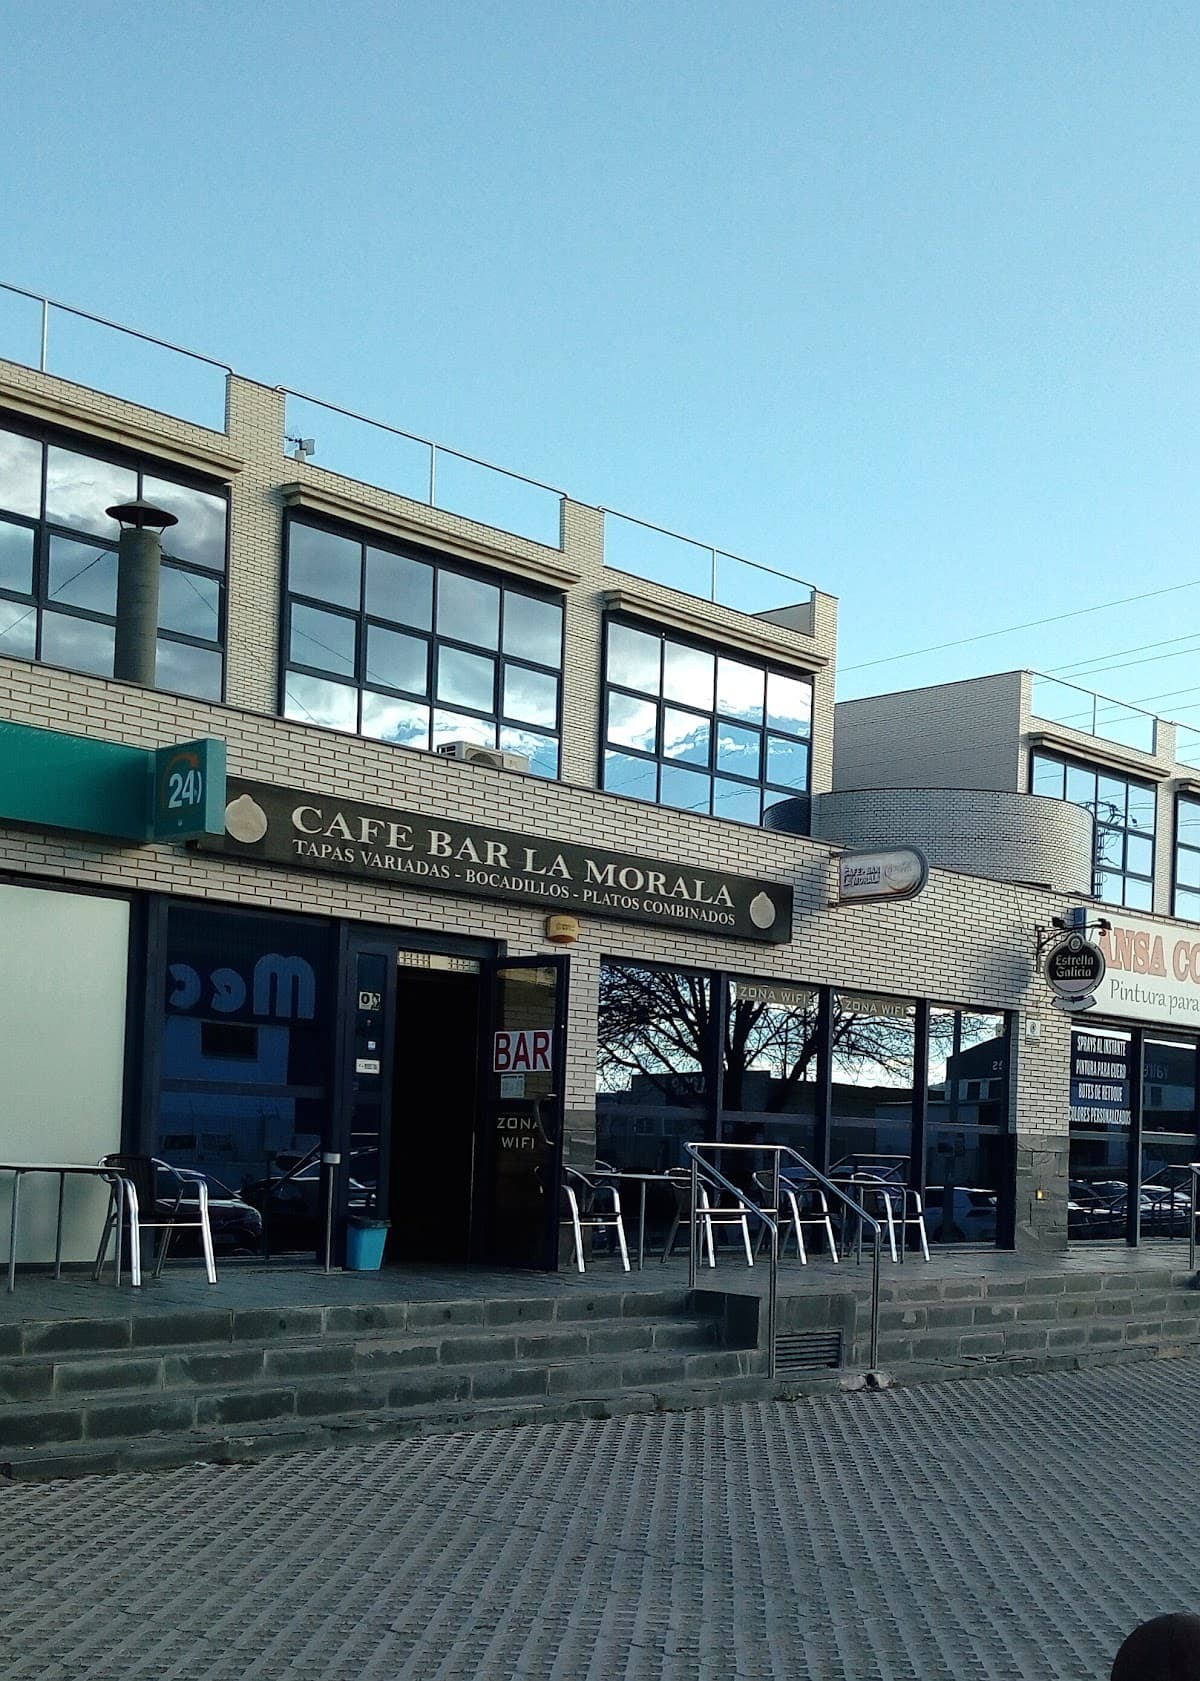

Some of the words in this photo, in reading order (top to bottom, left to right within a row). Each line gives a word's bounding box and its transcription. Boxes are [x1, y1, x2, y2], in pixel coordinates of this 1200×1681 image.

[291, 805, 415, 851] CAFE
[427, 829, 511, 869] BAR
[523, 847, 574, 881] LA
[583, 858, 735, 908] MORALA
[292, 839, 355, 863] TAPAS
[360, 850, 450, 879] VARIADAS
[466, 869, 569, 899] BOCADILLOS
[583, 888, 639, 911] PLATOS
[643, 899, 735, 926] COMBINADOS
[1056, 954, 1094, 966] Estrella
[1056, 966, 1092, 977] Galicia
[740, 986, 776, 1000] ZONA
[781, 991, 806, 1004] WIFI
[1110, 979, 1167, 1006] Pintura
[1169, 995, 1199, 1015] para
[845, 1000, 877, 1013] ZONA
[881, 1004, 904, 1016] WIFI
[494, 1032, 550, 1070] BAR
[501, 1136, 535, 1150] WIFI
